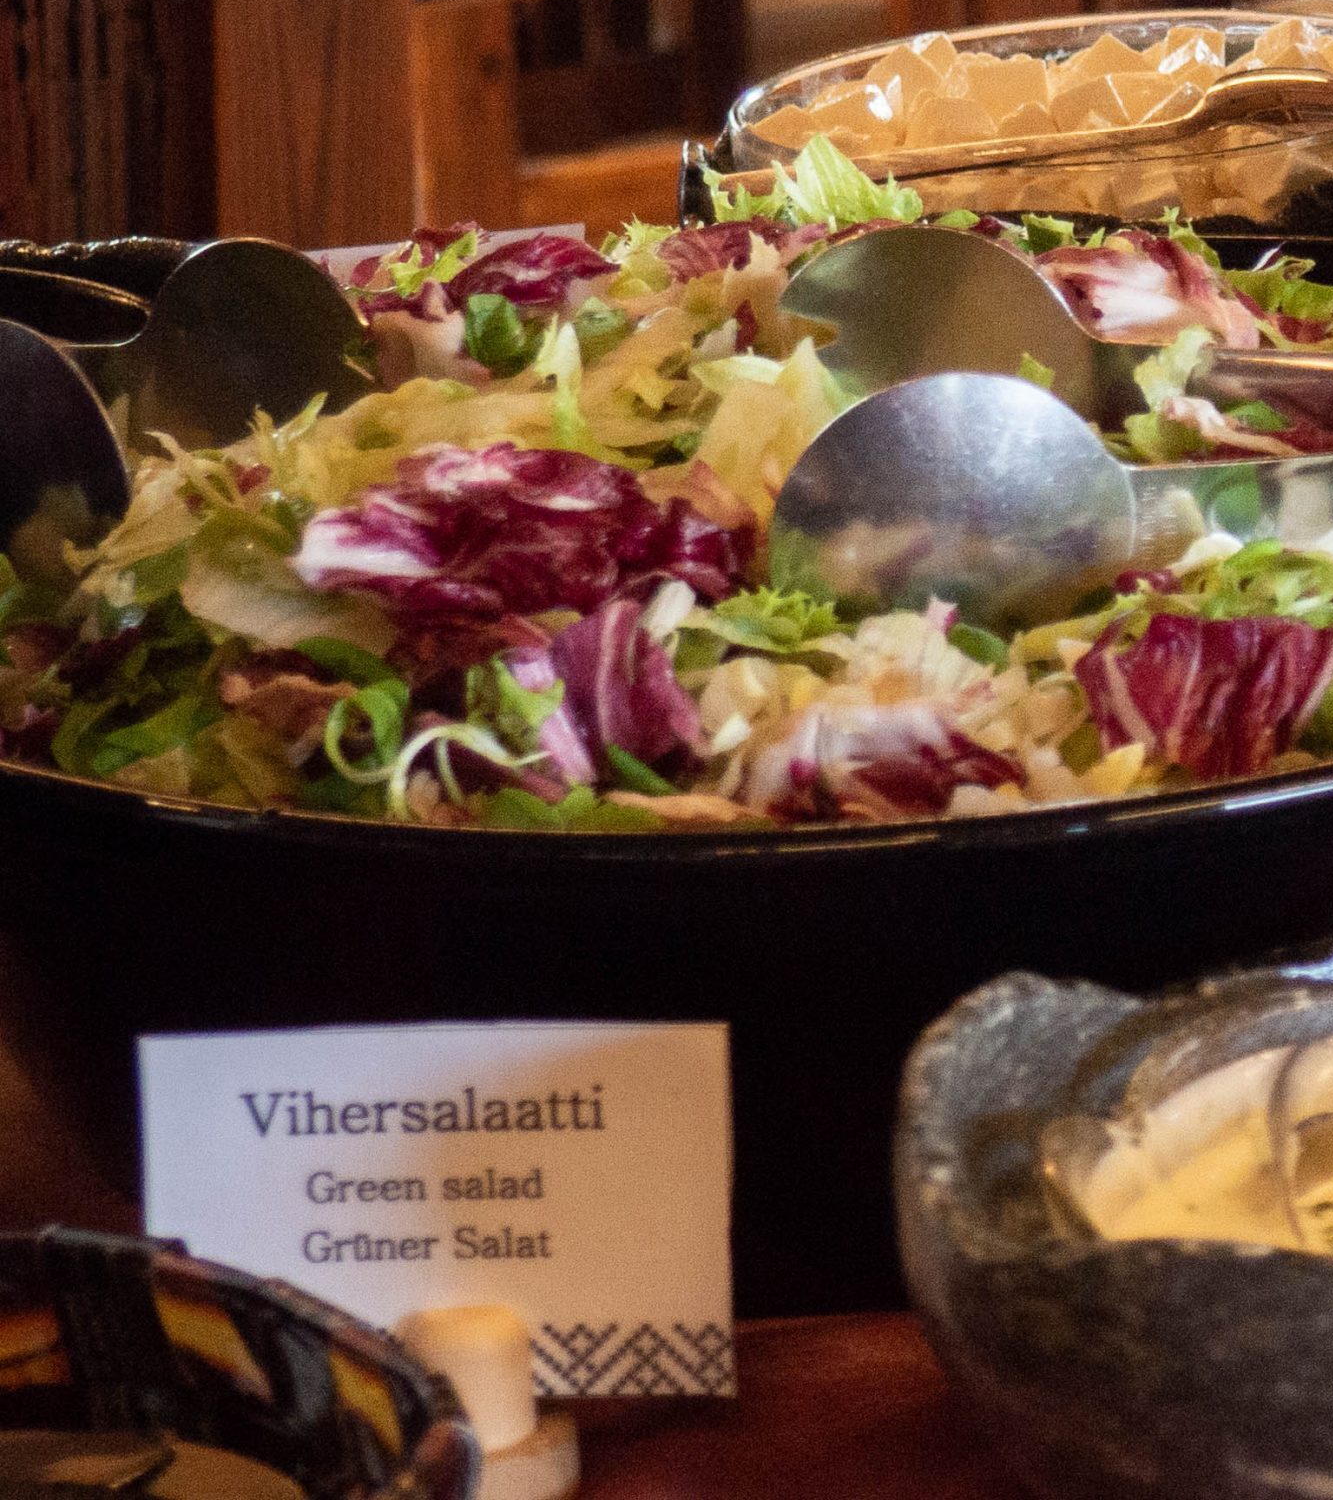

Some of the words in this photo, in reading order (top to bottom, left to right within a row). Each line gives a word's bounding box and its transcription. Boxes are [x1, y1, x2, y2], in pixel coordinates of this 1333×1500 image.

[239, 1085, 606, 1138] Vihersalaatti
[305, 1169, 427, 1204] Green
[441, 1167, 545, 1202] salad
[302, 1229, 438, 1264] Grüner
[453, 1226, 552, 1262] Salat
